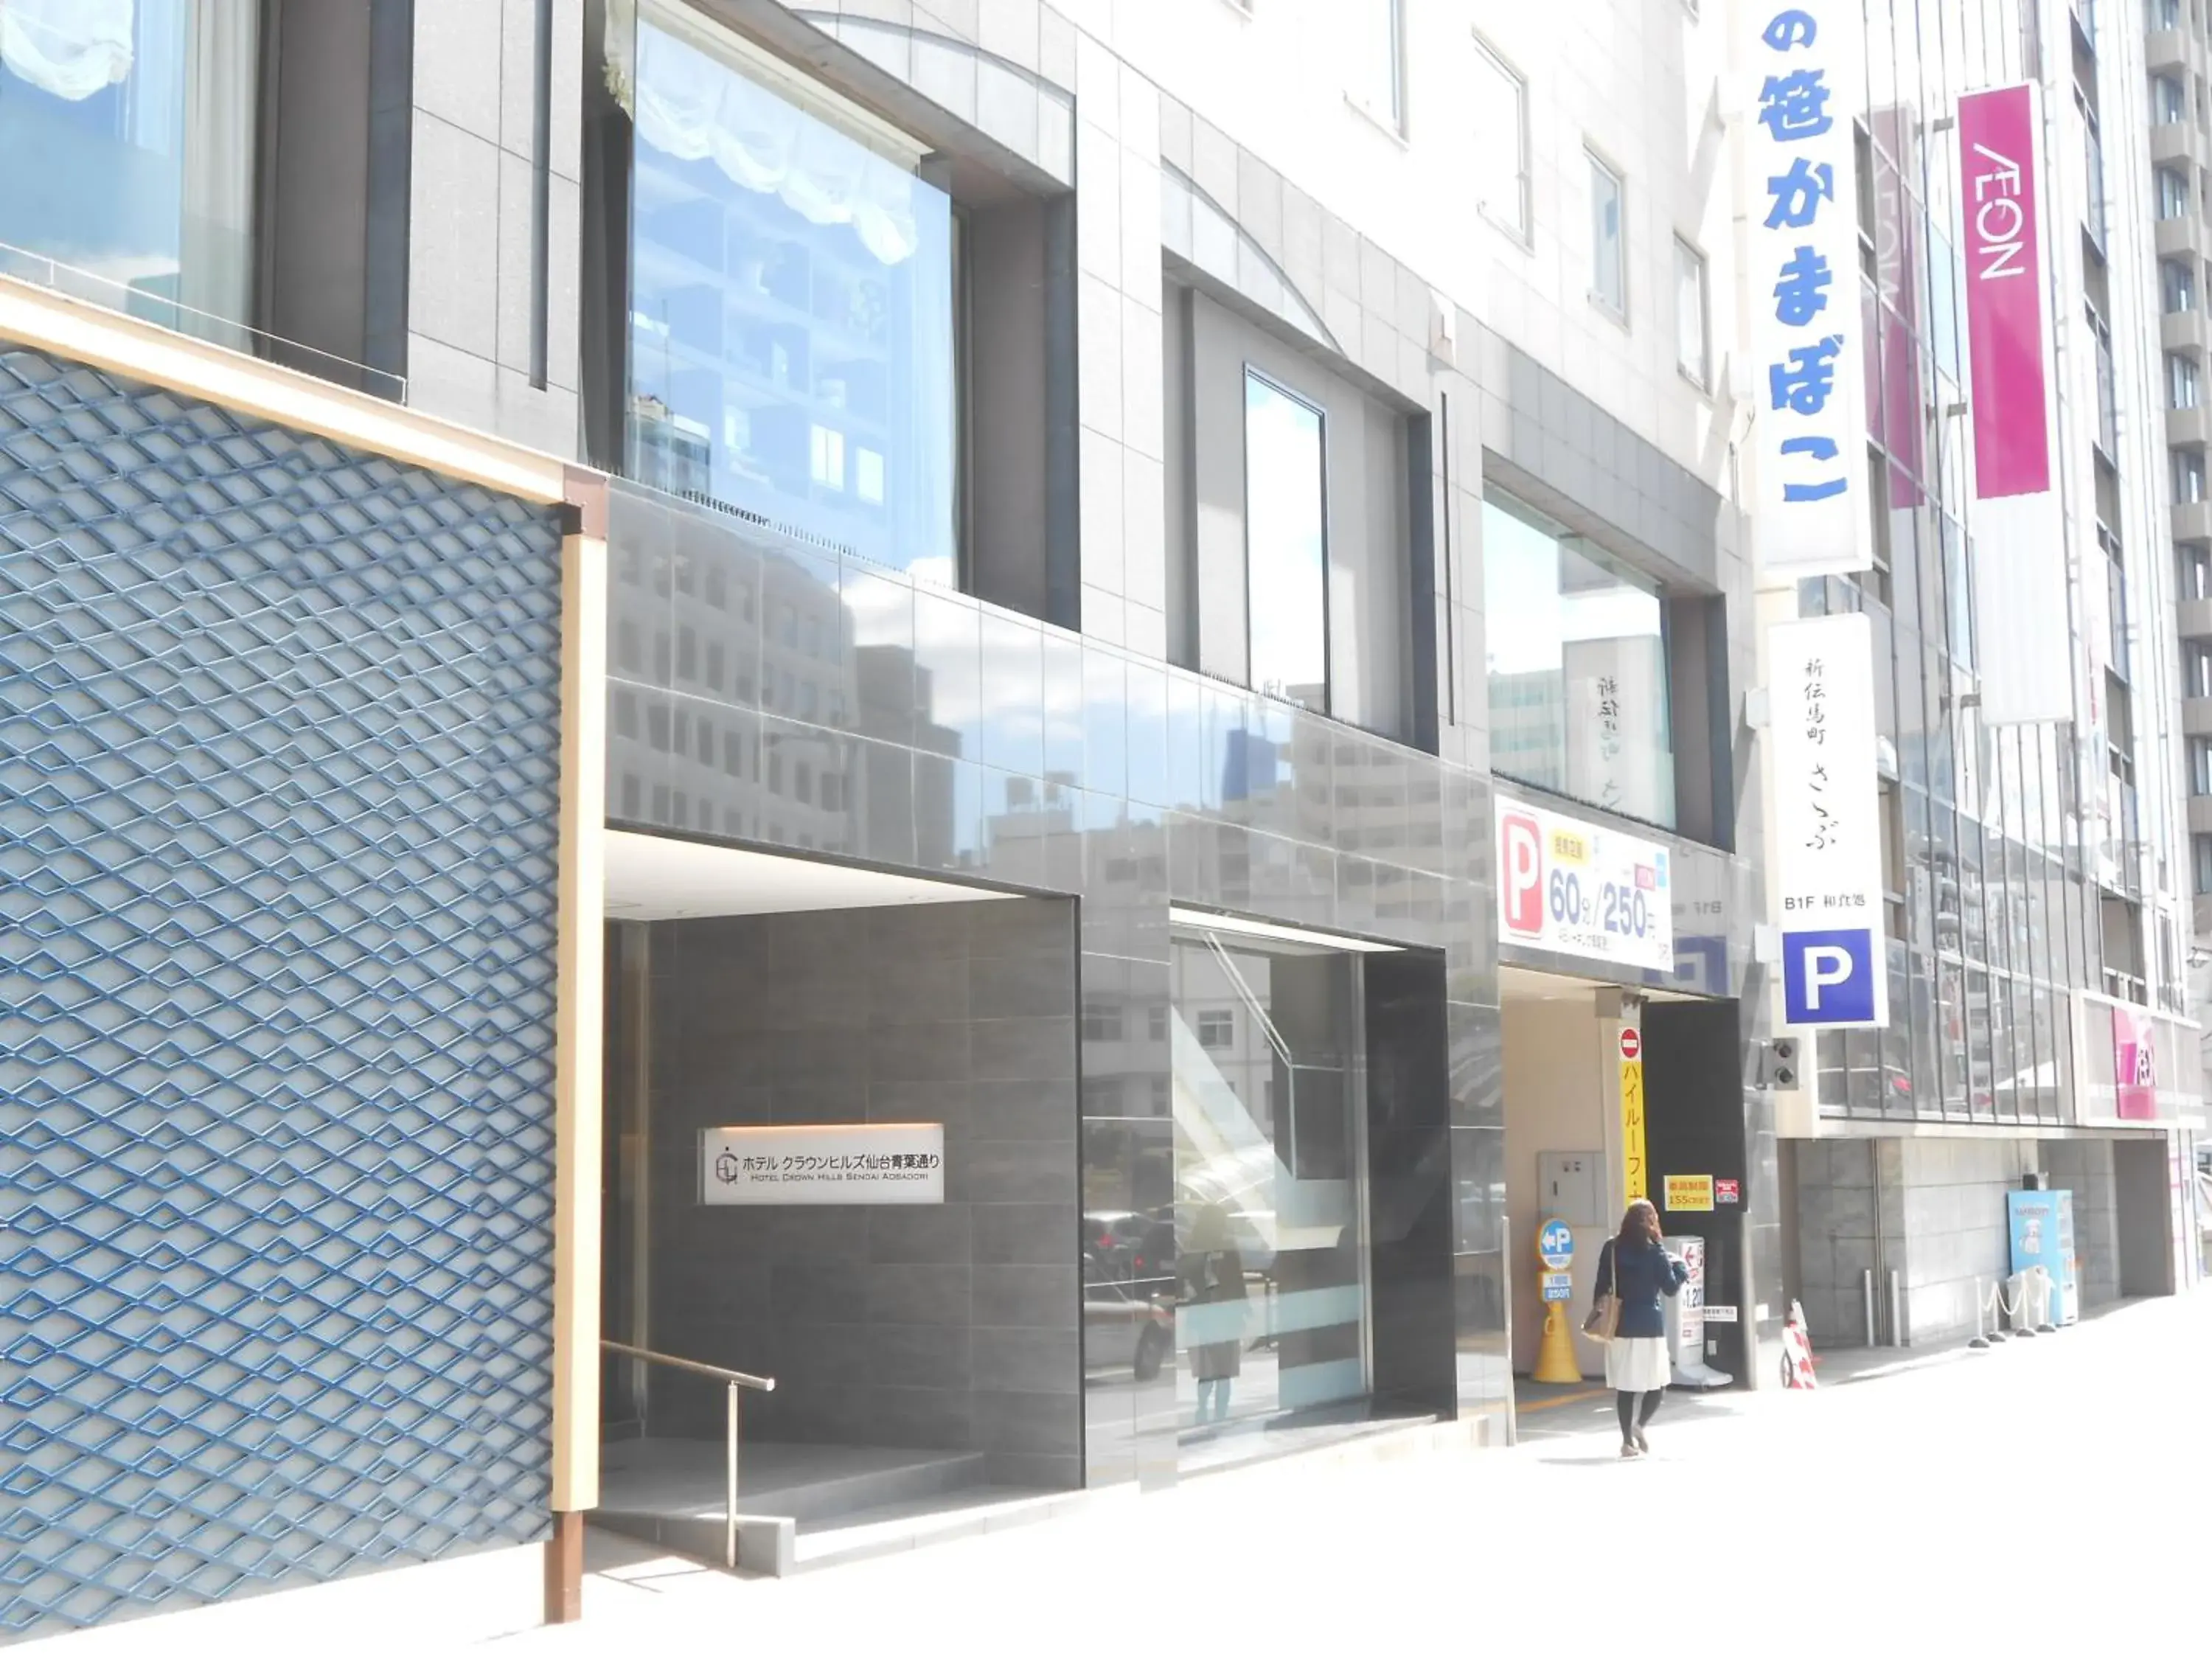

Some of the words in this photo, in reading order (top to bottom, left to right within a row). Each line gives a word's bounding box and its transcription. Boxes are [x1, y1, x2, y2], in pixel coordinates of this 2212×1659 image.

[1759, 9, 1848, 503] の笹かまぼこ
[1804, 658, 1826, 745] 新伝馬町
[1509, 823, 1540, 921] P
[1784, 895, 1815, 910] B1F
[1803, 945, 1853, 1010] P
[742, 1155, 778, 1171] ホテル
[1556, 1227, 1571, 1253] P
